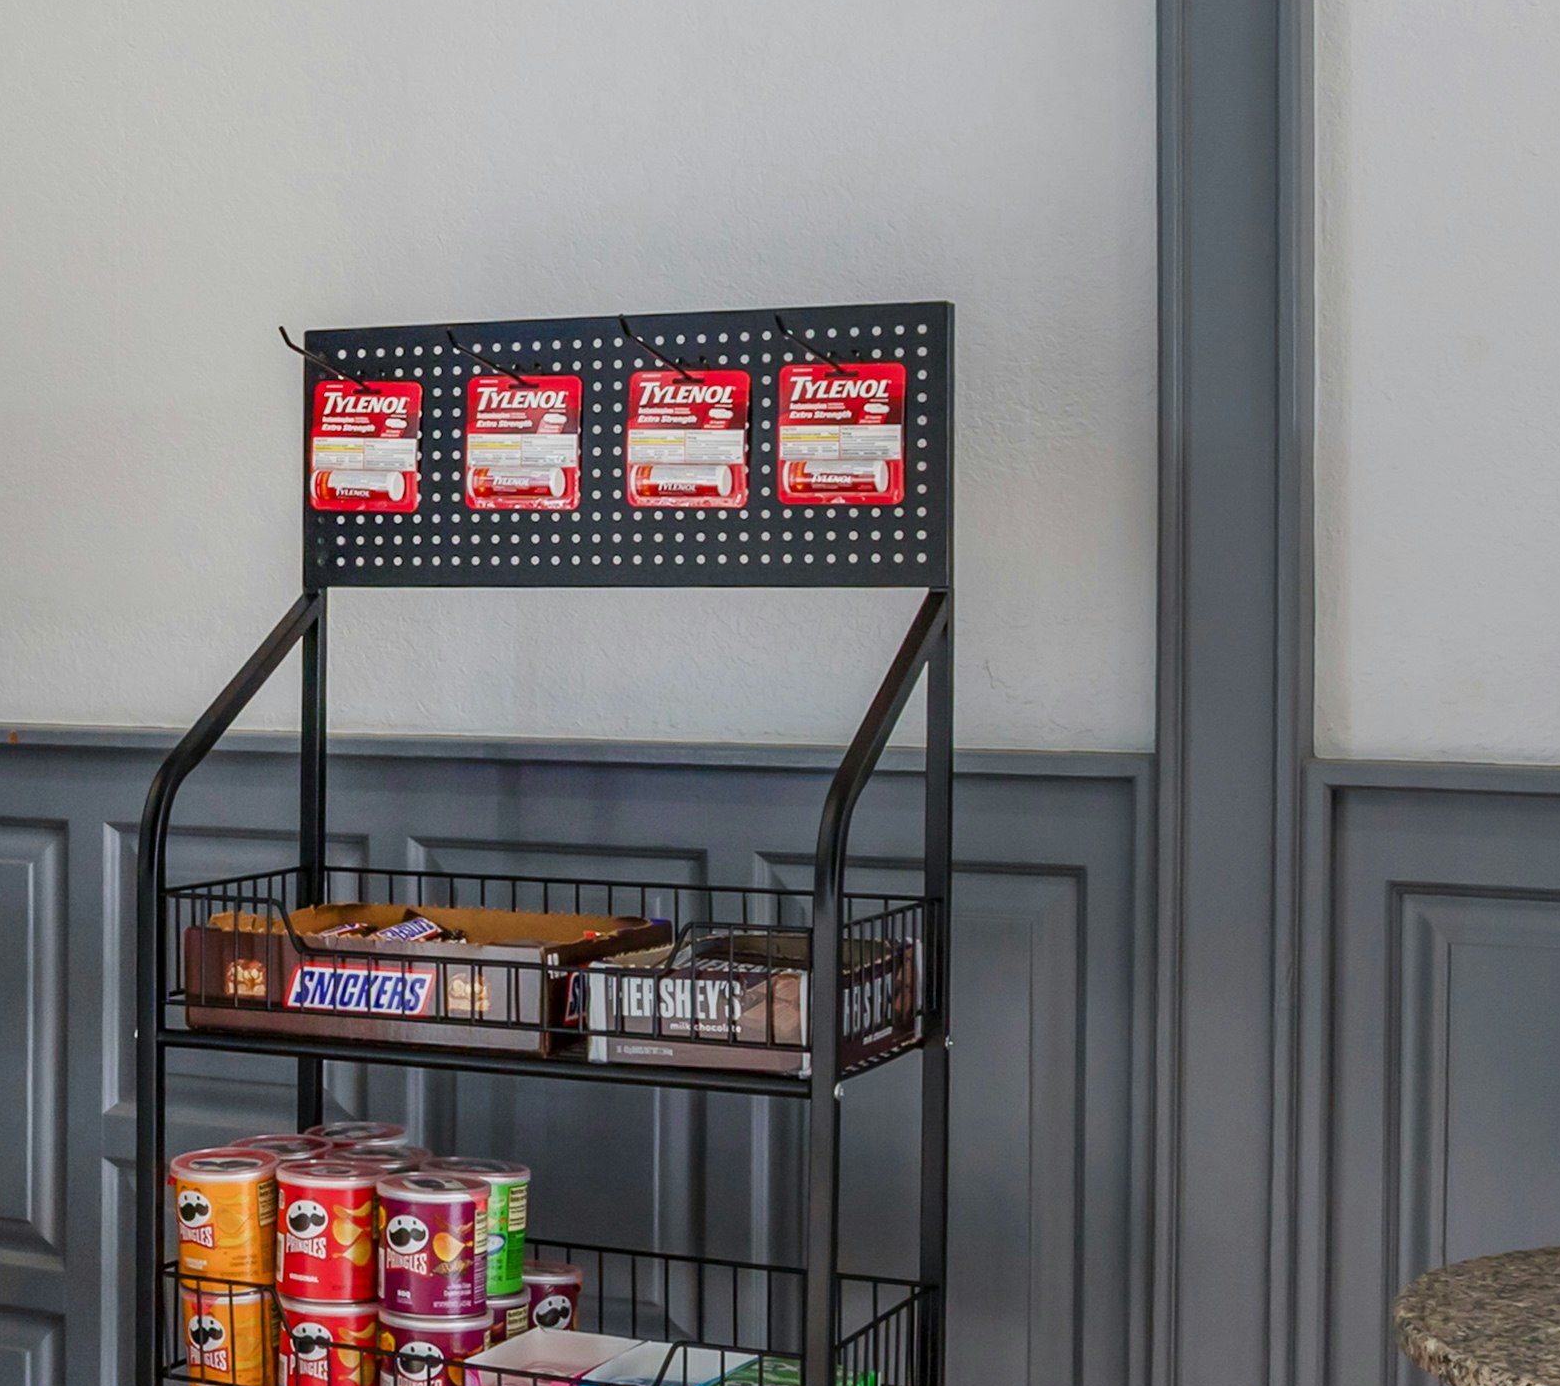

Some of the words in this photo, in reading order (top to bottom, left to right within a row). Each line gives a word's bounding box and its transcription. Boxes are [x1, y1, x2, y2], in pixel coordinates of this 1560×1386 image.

[476, 386, 568, 410] TYLENOL
[638, 381, 734, 406] TYLENOL
[789, 376, 890, 401] TYLENOL
[322, 391, 408, 415] TYLENOL
[294, 968, 426, 1012] SNICKERS
[285, 1236, 327, 1259] PRINGLES
[385, 1252, 428, 1275] PRINGLES
